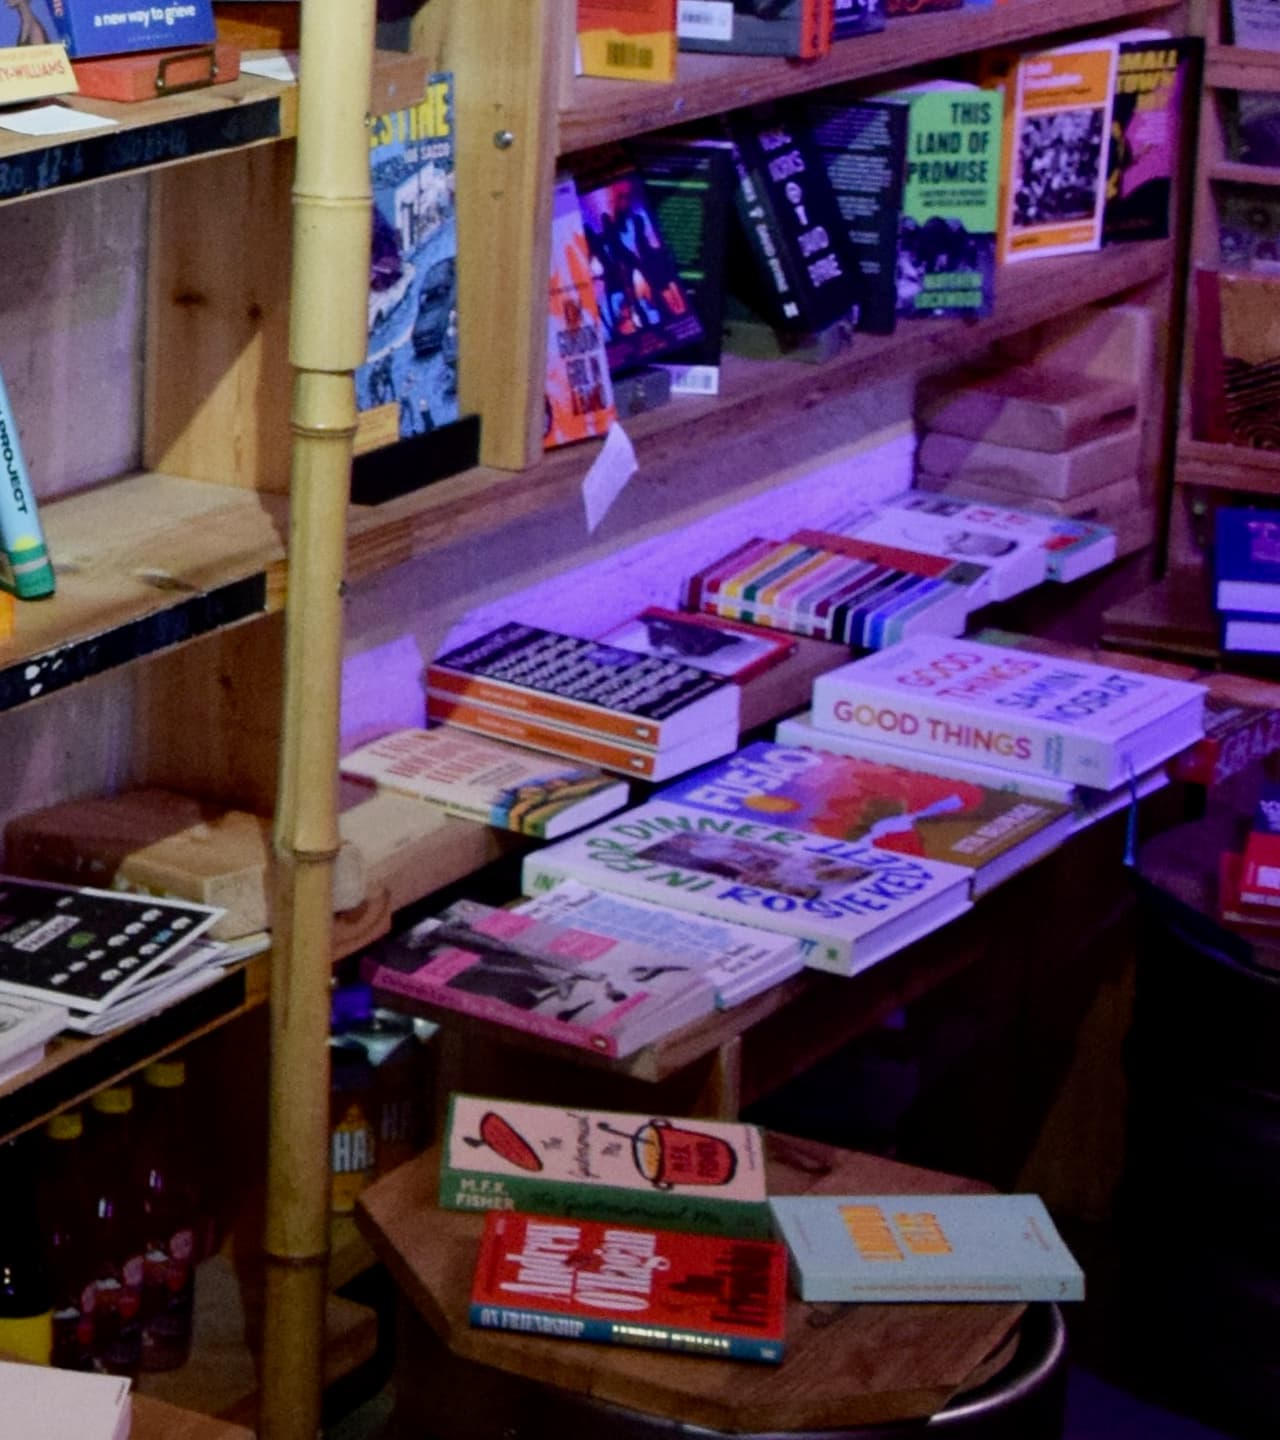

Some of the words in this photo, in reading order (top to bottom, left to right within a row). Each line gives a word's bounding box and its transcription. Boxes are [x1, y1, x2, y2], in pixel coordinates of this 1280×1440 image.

[94, 14, 100, 26] a
[102, 10, 127, 25] new
[128, 10, 150, 28] way
[151, 8, 163, 20] to
[165, 3, 196, 25] grieve
[951, 101, 992, 125] THIS
[916, 132, 961, 156] LAND
[967, 131, 990, 153] OF
[907, 160, 989, 183] PROMISE
[895, 651, 983, 688] GOOD
[832, 699, 919, 736] GOOD
[926, 719, 1033, 760] THINGS
